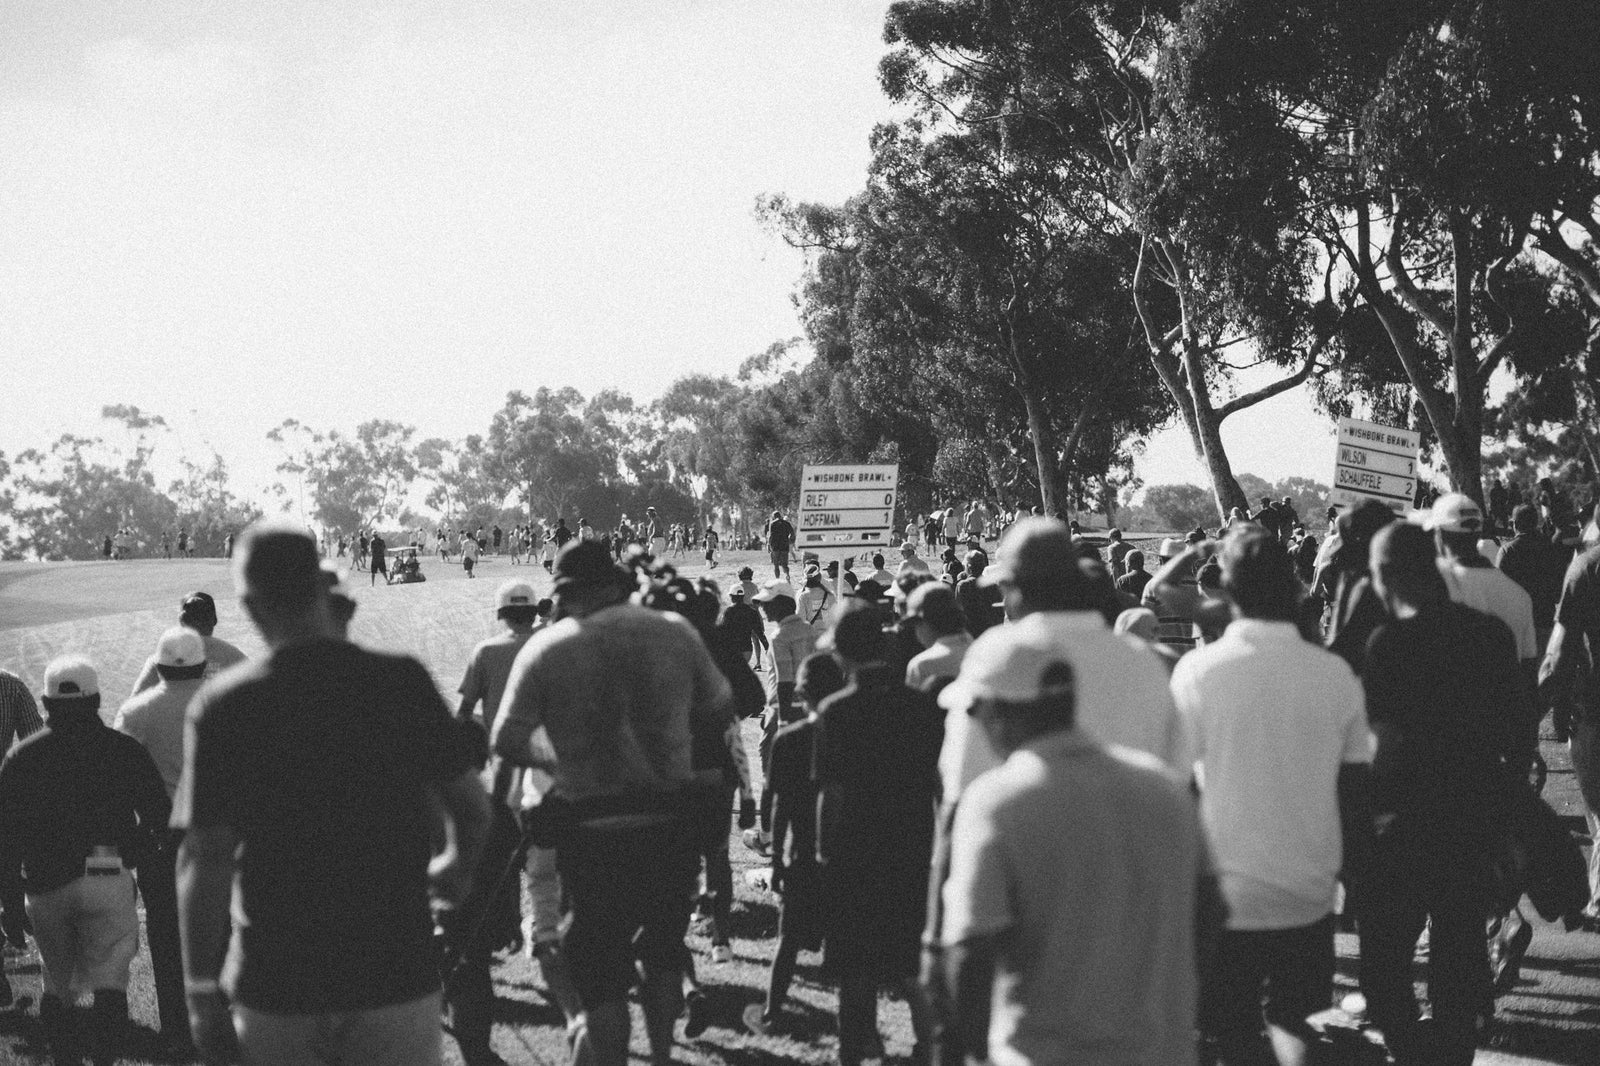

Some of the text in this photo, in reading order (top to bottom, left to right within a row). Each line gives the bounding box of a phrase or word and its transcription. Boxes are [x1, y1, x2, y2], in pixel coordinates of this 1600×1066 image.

[1349, 427, 1410, 448] WISHBONE BRAWL
[1341, 448, 1413, 474] WILSON 1
[814, 474, 885, 483] WISHBONE BRAWL
[1340, 470, 1412, 495] SCHAUFFELE 2
[806, 494, 892, 507] RILEY 0
[804, 512, 888, 526] HOFFMAN 1
